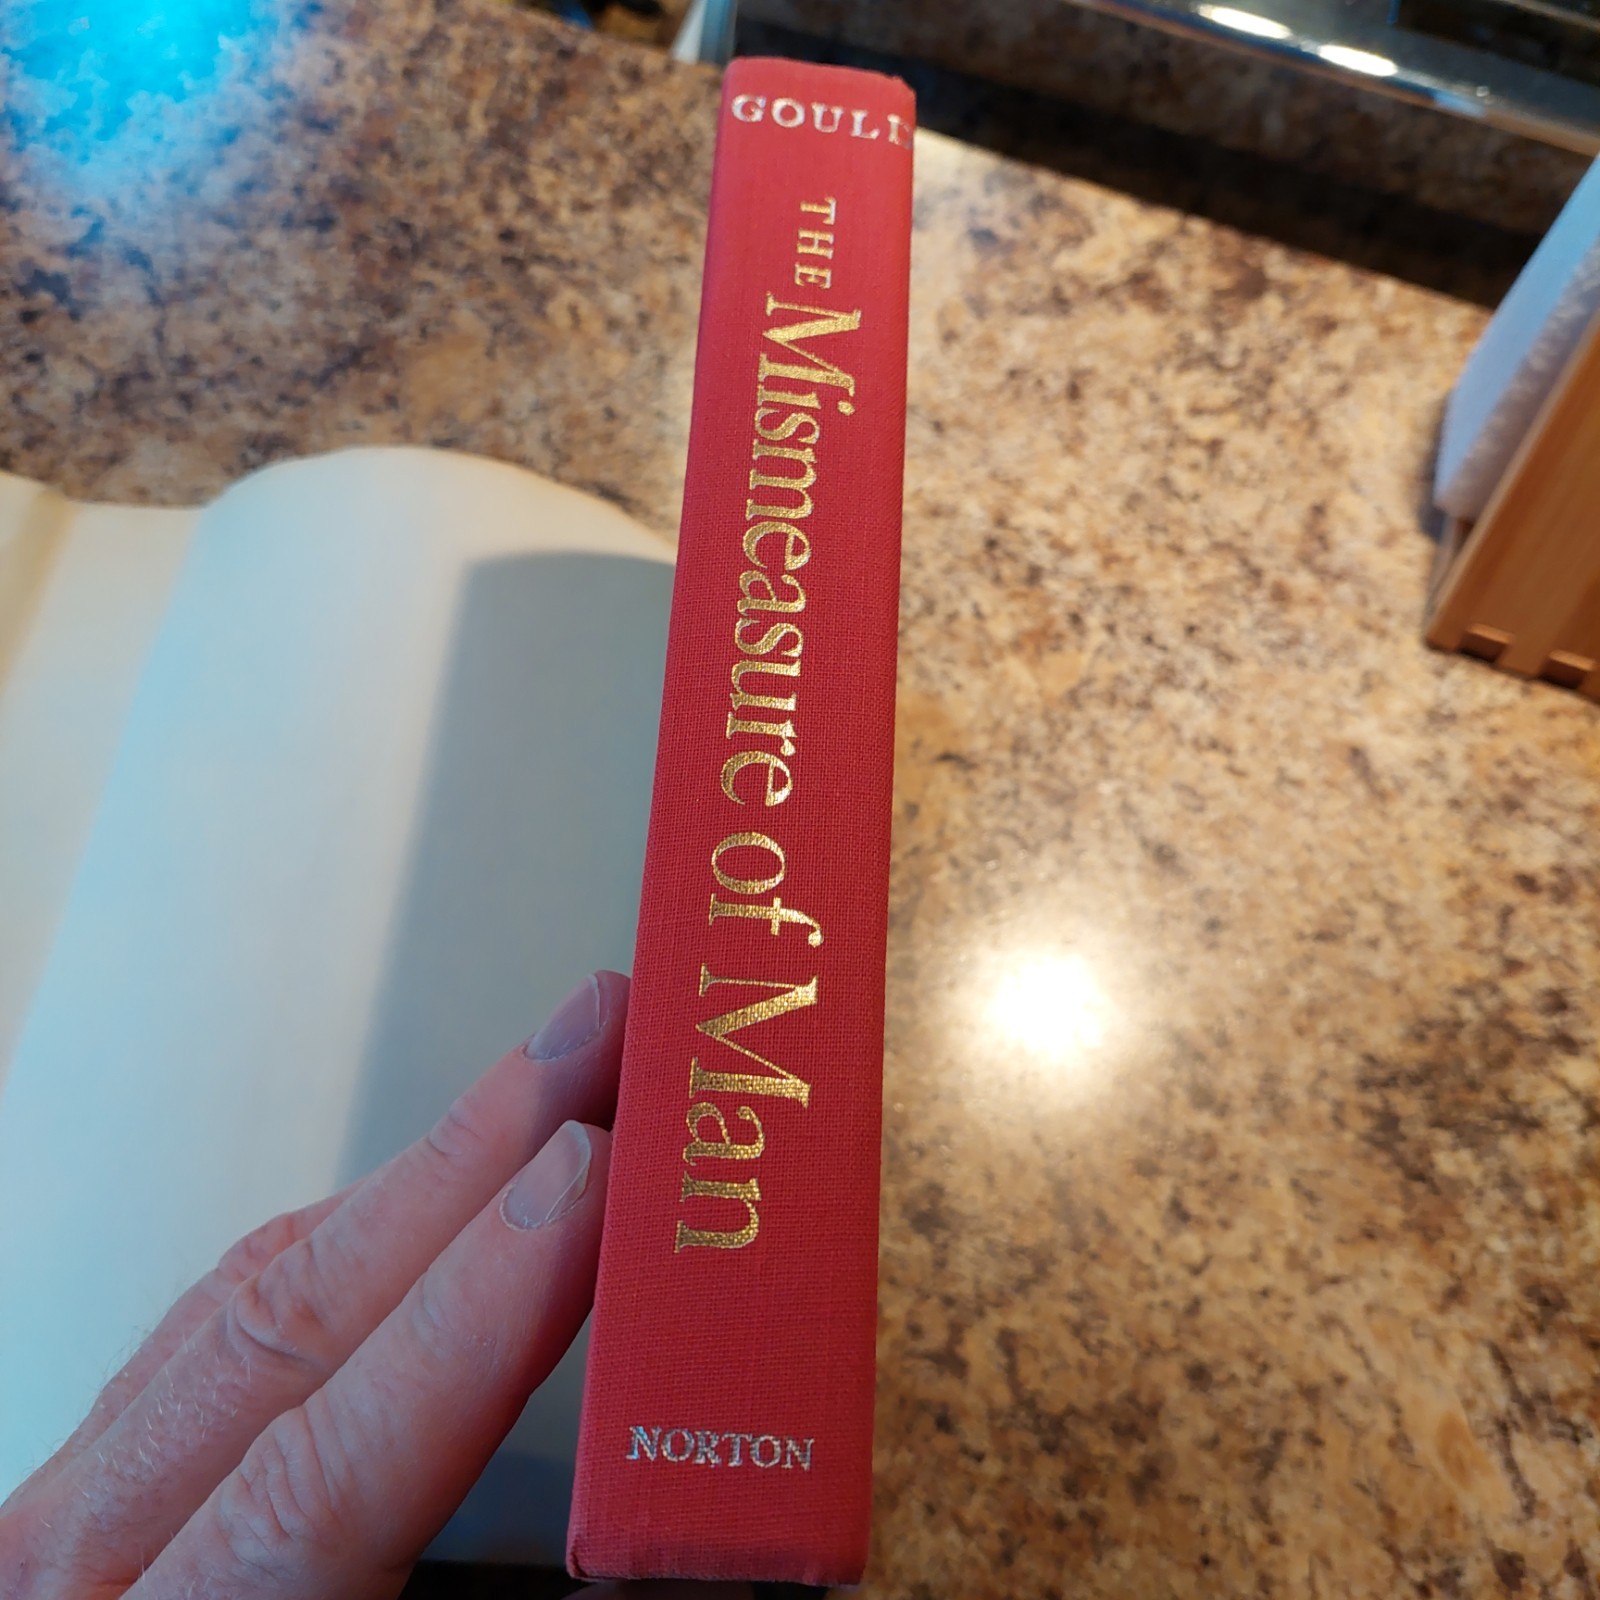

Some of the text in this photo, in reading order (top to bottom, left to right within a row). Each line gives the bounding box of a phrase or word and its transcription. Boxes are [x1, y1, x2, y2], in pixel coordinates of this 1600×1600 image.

[673, 196, 862, 1254] THE Mismeasure of Man
[626, 1425, 815, 1471] NORTON
